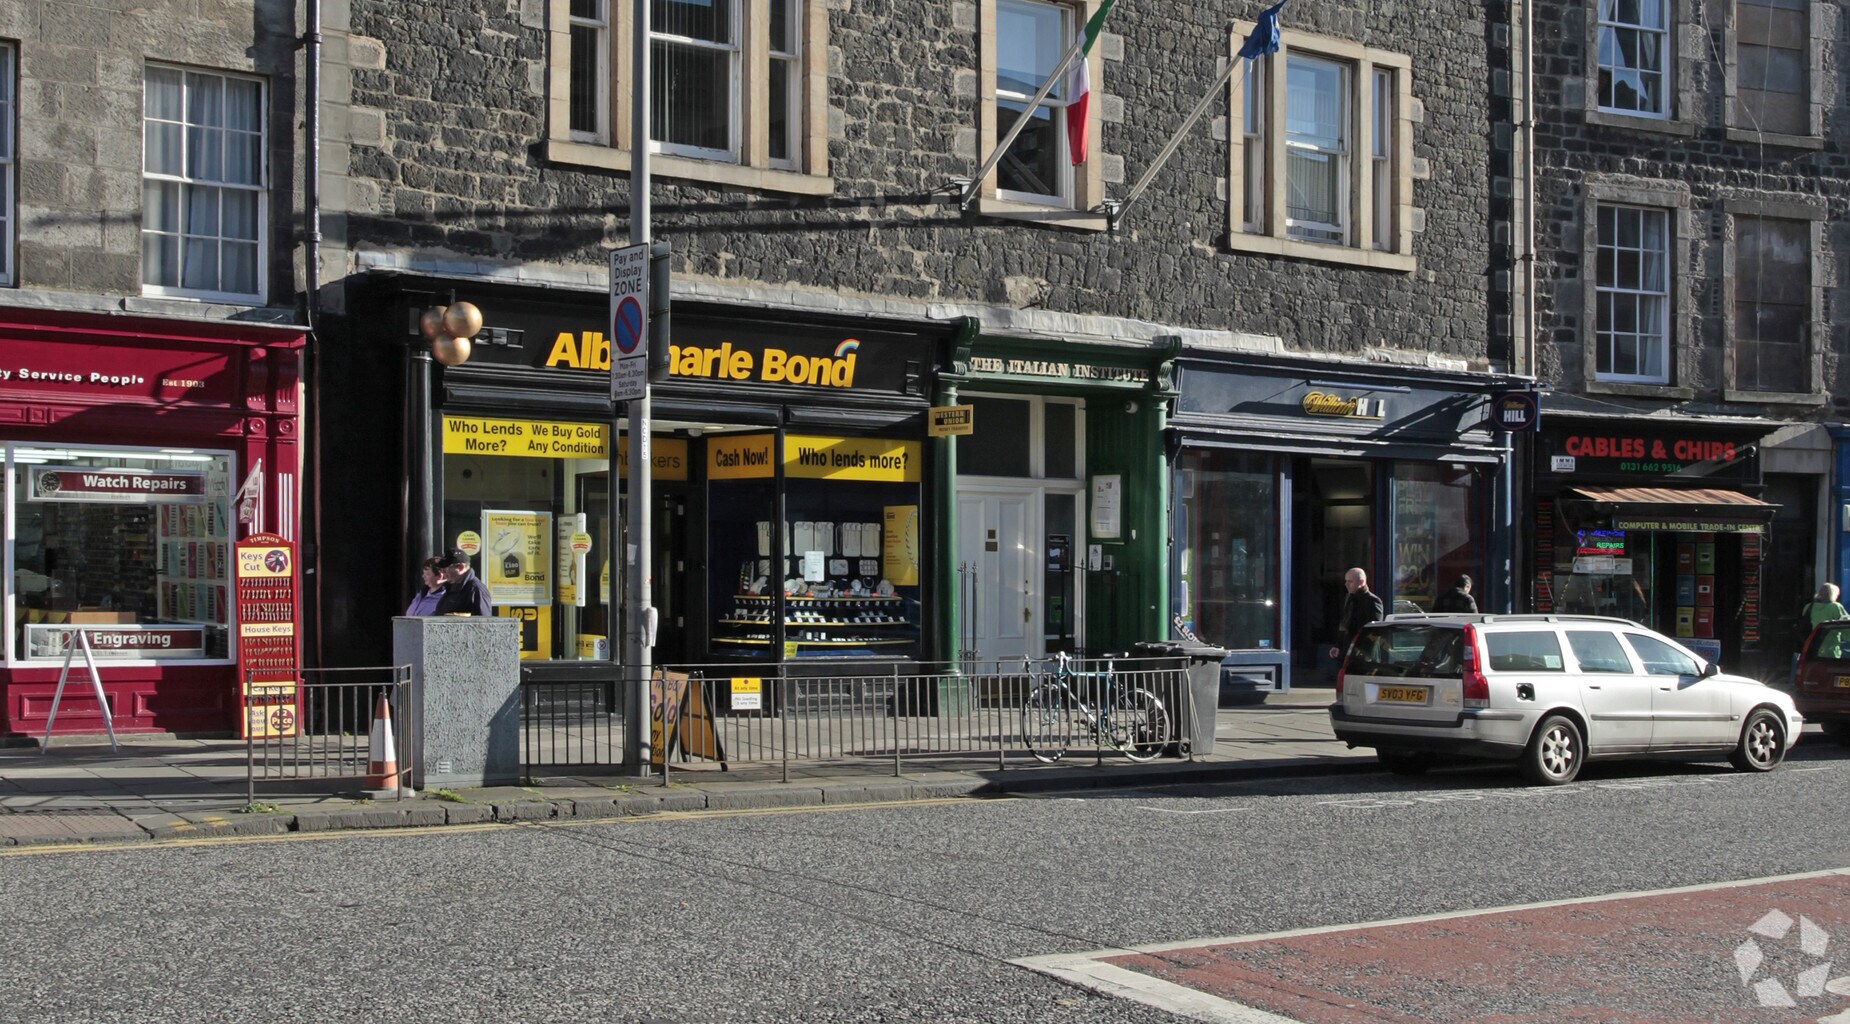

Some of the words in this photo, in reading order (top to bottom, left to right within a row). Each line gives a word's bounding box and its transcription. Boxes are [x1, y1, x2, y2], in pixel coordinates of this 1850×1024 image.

[613, 253, 628, 266] Pay
[629, 249, 644, 263] and
[614, 265, 643, 280] Display
[614, 278, 642, 297] ZONE
[546, 331, 753, 380] Albarle
[761, 348, 857, 388] Bond
[970, 357, 1002, 373] THE
[1008, 360, 1069, 376] ITALIAN
[1074, 364, 1150, 382] INSTITUTE
[19, 368, 82, 382] Service
[90, 372, 144, 387] People
[162, 378, 179, 387] Est
[180, 379, 205, 388] 1903
[1503, 410, 1526, 422] HILL
[449, 420, 478, 434] Who
[483, 422, 523, 436] Lends
[531, 424, 549, 436] We
[552, 425, 573, 439] Buy
[576, 427, 601, 439] Gold
[465, 438, 507, 452] More?
[528, 440, 549, 454] Any
[552, 440, 604, 454] Condition
[1565, 436, 1645, 458] CABLES
[1651, 439, 1668, 459] &
[1674, 440, 1736, 462] CHIPS
[716, 448, 740, 467] Cash
[743, 447, 768, 466] Now!
[798, 447, 827, 467] Who
[831, 448, 866, 468] lends
[869, 452, 909, 470] more?
[1620, 462, 1640, 471] 0131
[1642, 463, 1660, 472] 662
[1661, 463, 1682, 472] 9516
[83, 475, 129, 489] Watch
[132, 476, 187, 491] Repairs
[1618, 521, 1660, 529] COMPUTER
[1661, 522, 1668, 530] &
[1669, 522, 1698, 530] MOBILE
[1700, 523, 1736, 531] TRADE-IN
[1738, 523, 1765, 532] CENTRE
[250, 536, 280, 544] TIMPSON
[240, 552, 263, 561] Keys
[1398, 543, 1430, 565] WIN
[244, 563, 261, 571] Cut
[524, 574, 545, 582] Bond
[244, 625, 270, 633] House
[272, 624, 291, 634] Keys
[93, 632, 171, 648] Engraving
[1381, 688, 1404, 699] SV03
[1406, 689, 1424, 701] YFG
[271, 717, 292, 725] Prce
